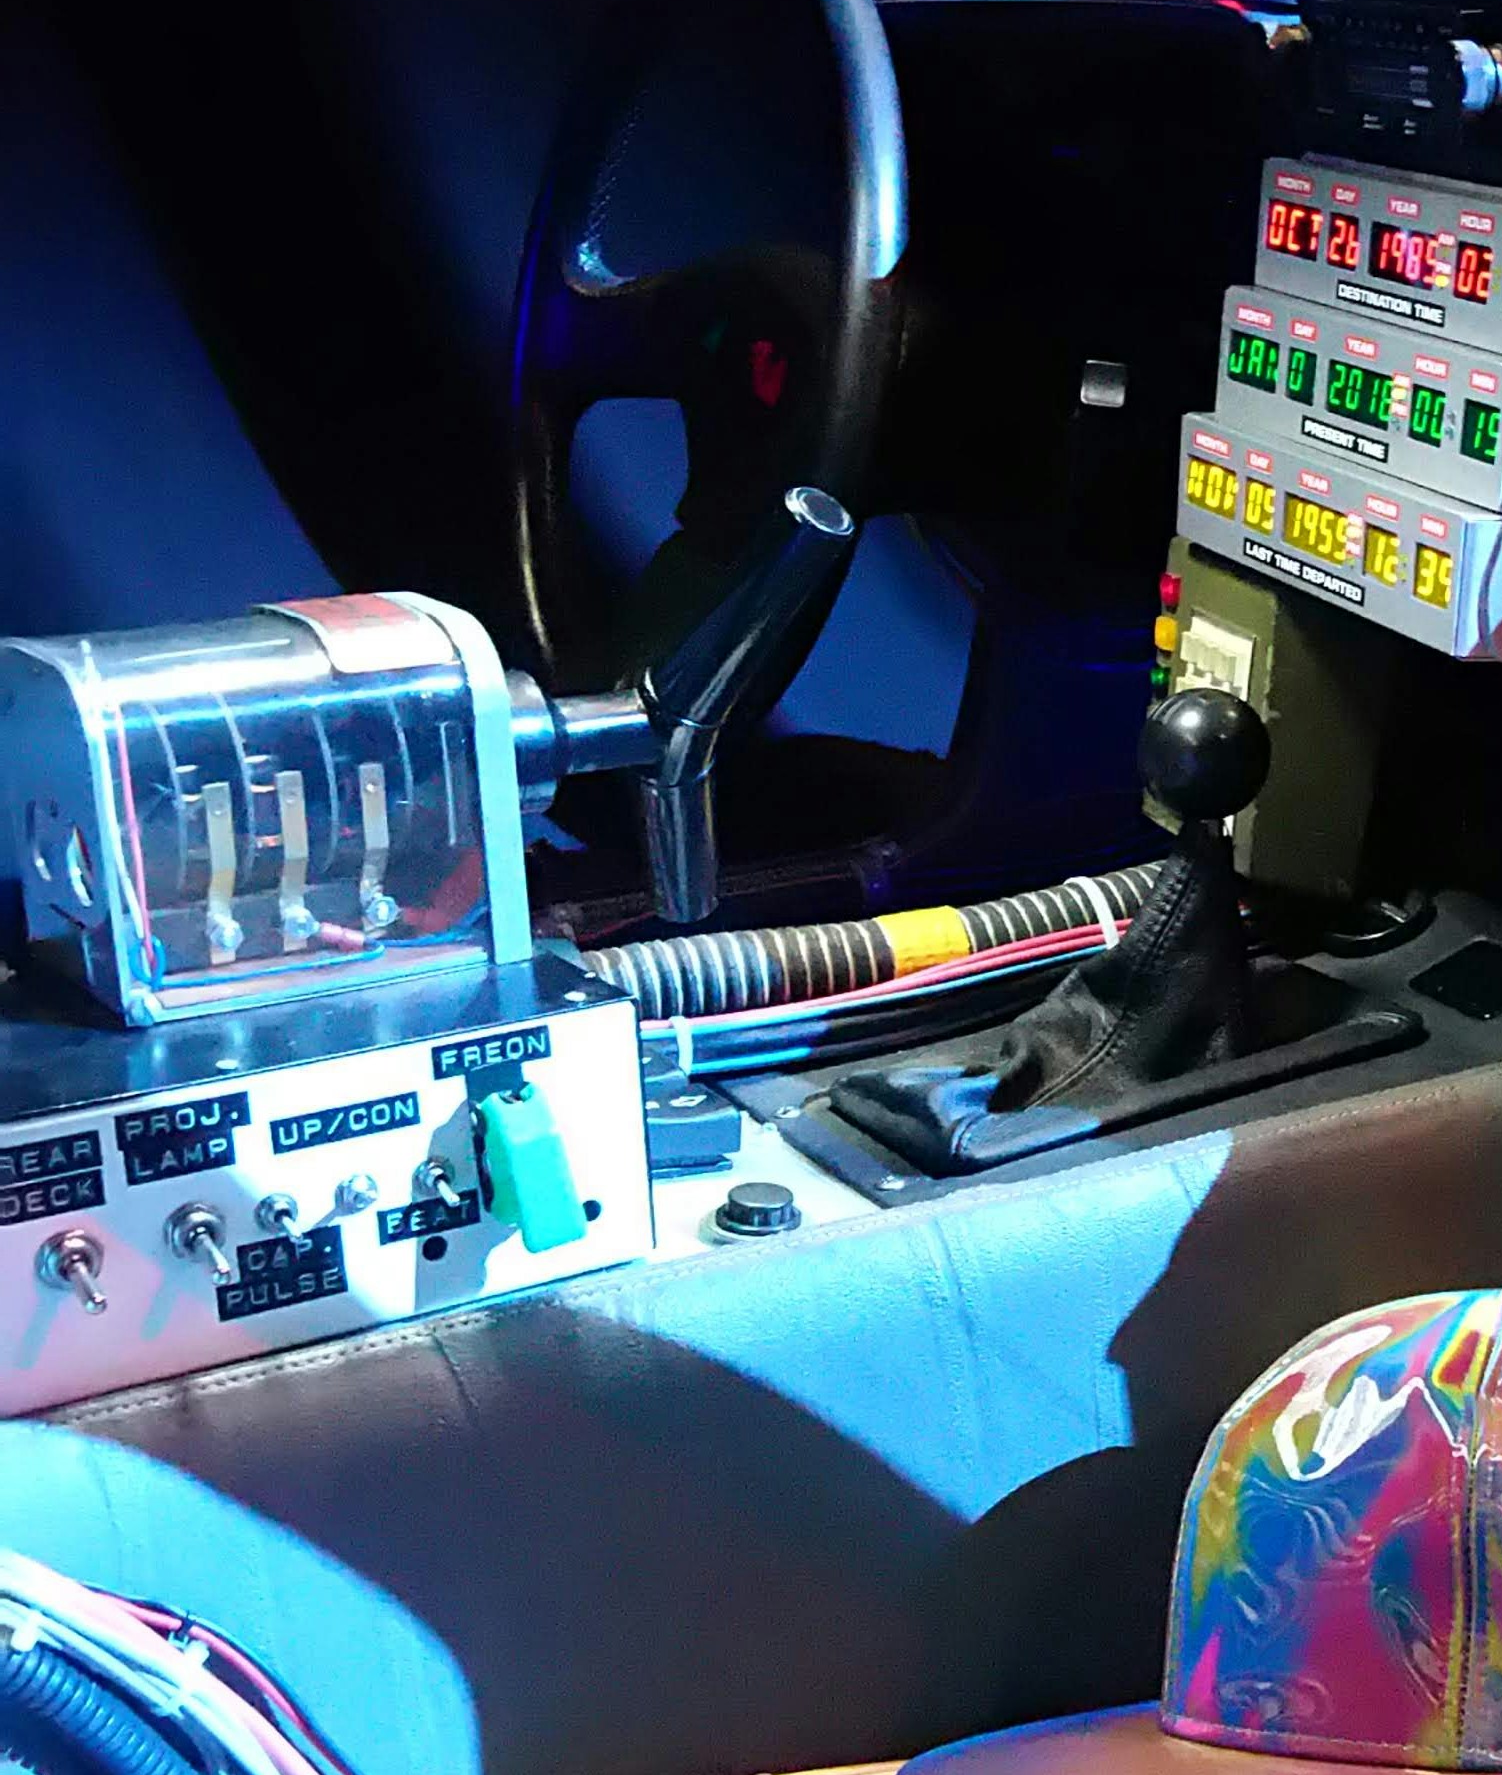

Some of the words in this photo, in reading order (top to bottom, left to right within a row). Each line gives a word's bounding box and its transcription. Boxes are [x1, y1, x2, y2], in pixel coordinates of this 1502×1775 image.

[1335, 188, 1356, 203] DAY
[1389, 199, 1419, 217] YEAR
[1460, 213, 1493, 232] HOUR
[1269, 204, 1324, 252] OCT
[1329, 219, 1361, 266] 26
[1379, 230, 1438, 285] 1985
[1338, 283, 1412, 316] DESTINATION
[1414, 303, 1445, 325] TIME
[1347, 337, 1376, 357] YEAR
[1304, 419, 1356, 449] PRESENT
[1356, 437, 1386, 460] TIME
[1245, 541, 1274, 564] LAST
[1274, 553, 1301, 577] TIME
[1302, 565, 1363, 603] DEPARTED
[439, 1031, 547, 1072] FREON
[124, 1101, 240, 1143] PROJ.
[277, 1096, 416, 1137] UP/CON
[0, 1139, 94, 1176] REAR
[134, 1136, 228, 1177] LAMP
[0, 1178, 94, 1219] DECK
[247, 1237, 332, 1271] CAP.
[226, 1266, 340, 1309] PULSE
